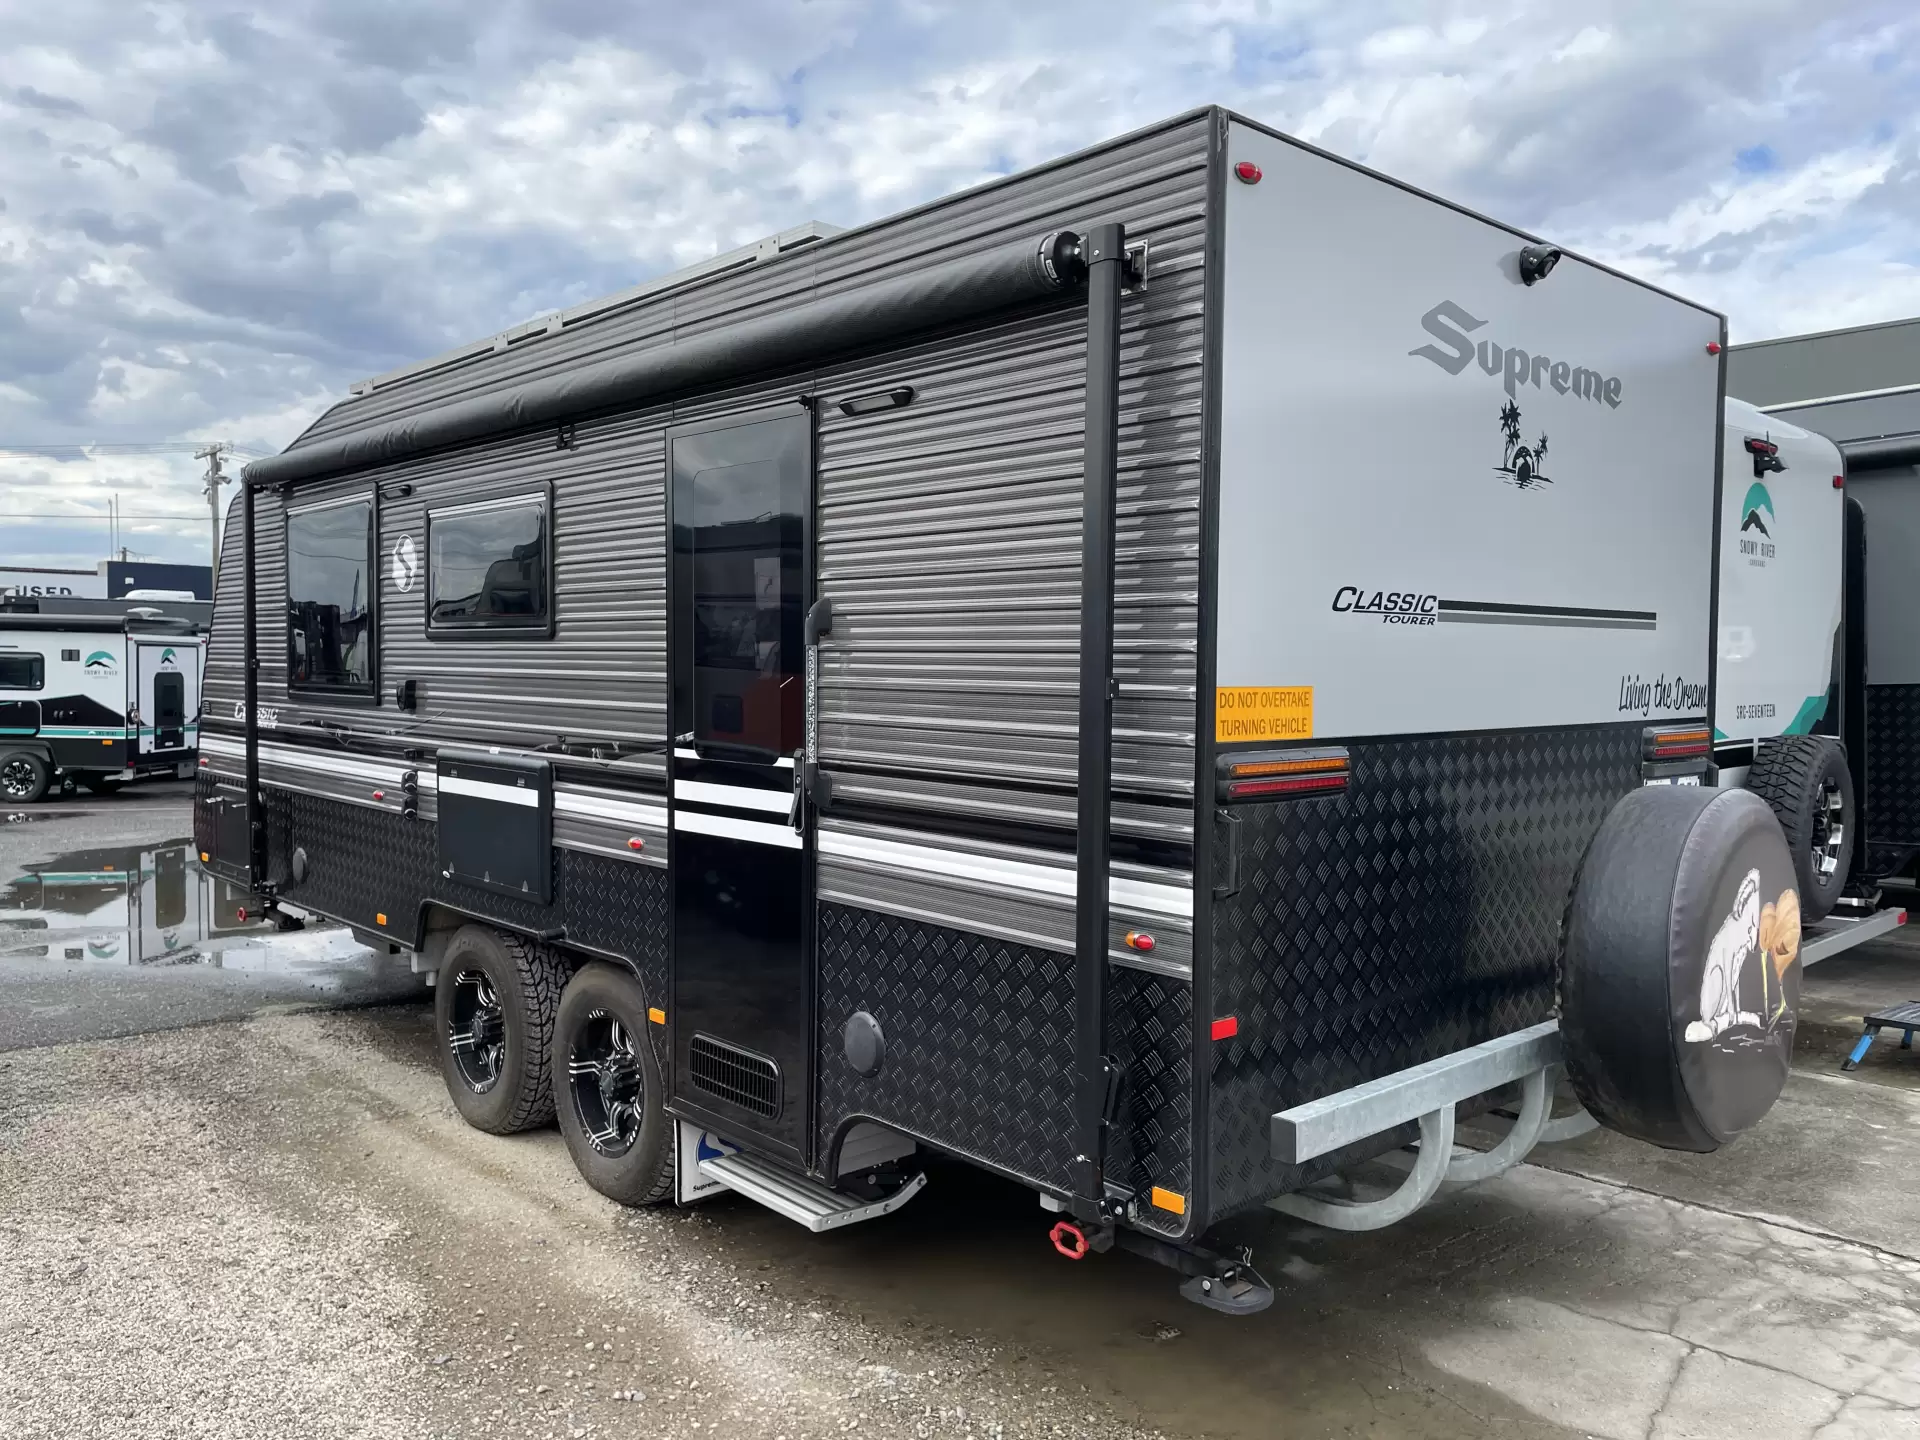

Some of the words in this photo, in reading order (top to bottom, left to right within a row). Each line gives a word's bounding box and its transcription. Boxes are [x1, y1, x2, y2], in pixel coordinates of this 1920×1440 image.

[1407, 299, 1623, 410] Supreme
[1739, 539, 1758, 556] SNOWY
[1760, 543, 1776, 559] RIVER
[1331, 586, 1438, 613] CLASSIC
[1382, 614, 1436, 626] TOURER
[1219, 692, 1235, 709] DO
[1237, 691, 1259, 709] NOT
[1260, 691, 1310, 708] OVERTAKE
[1618, 674, 1651, 717] Living
[1654, 672, 1672, 710] the
[1673, 675, 1707, 711] Dream
[1220, 719, 1266, 736] TURNING
[1268, 717, 1308, 734] VEHICLE
